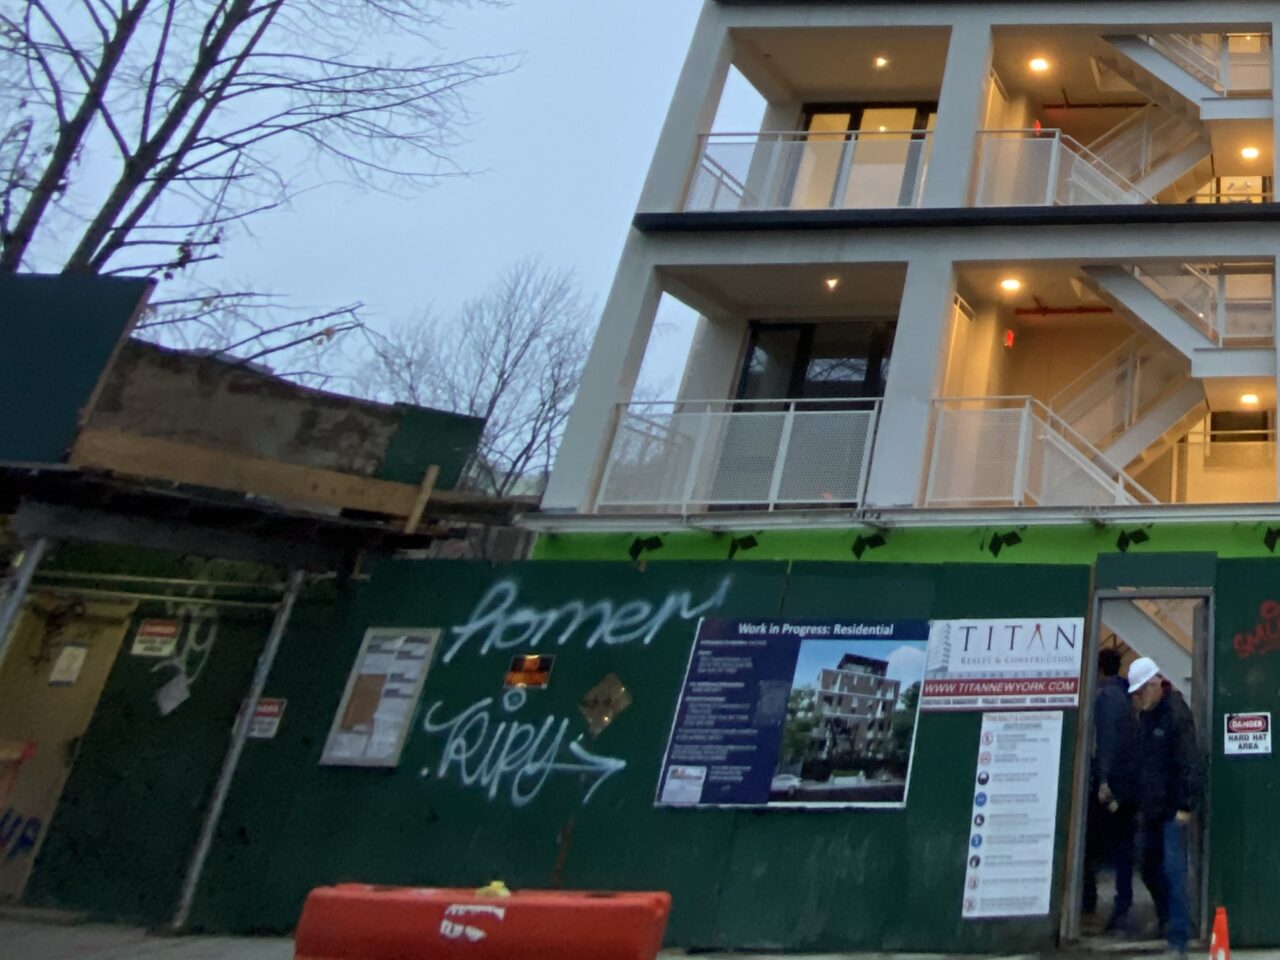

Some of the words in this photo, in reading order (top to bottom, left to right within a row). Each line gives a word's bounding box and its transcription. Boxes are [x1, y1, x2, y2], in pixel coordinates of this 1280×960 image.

[738, 623, 766, 634] Work
[769, 623, 779, 634] in
[782, 623, 830, 637] Progress:
[833, 624, 894, 635] Residential
[959, 624, 1077, 652] TITAN
[925, 681, 1075, 694] WWW.TITANNEWYORK.COM
[1232, 719, 1263, 729] DANGER
[1228, 734, 1250, 742] HARD
[1253, 733, 1267, 741] HAT
[1238, 742, 1259, 750] AREA
